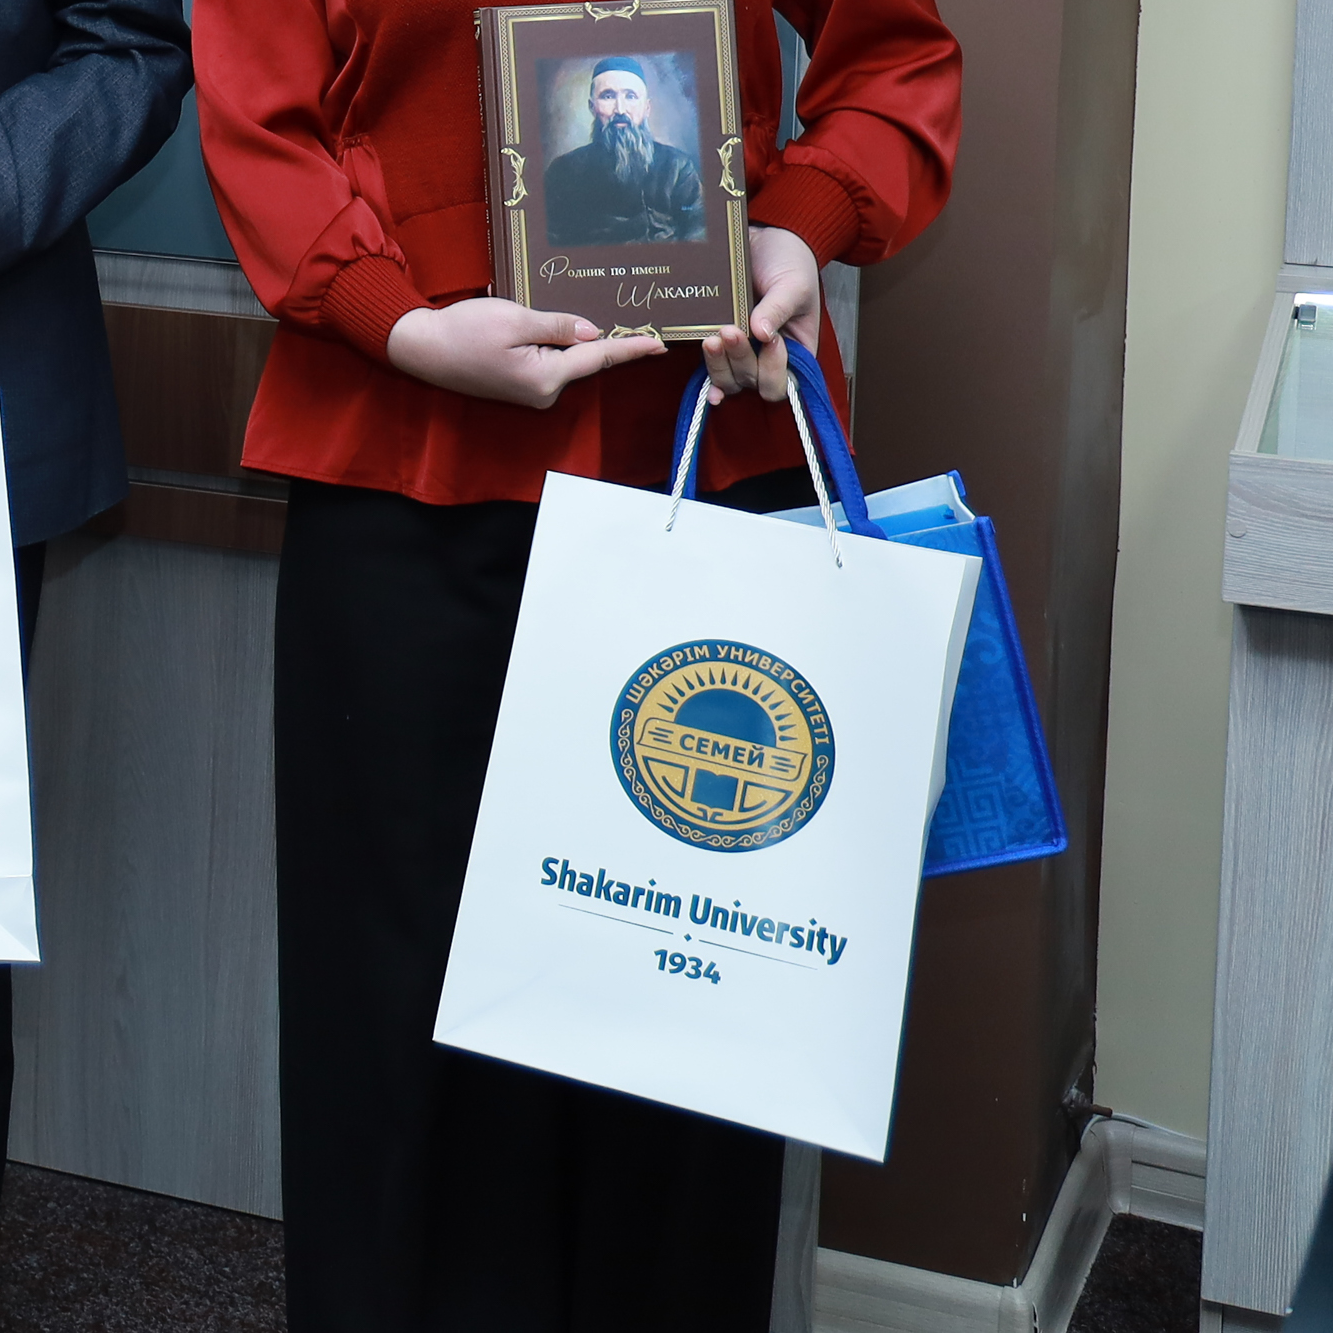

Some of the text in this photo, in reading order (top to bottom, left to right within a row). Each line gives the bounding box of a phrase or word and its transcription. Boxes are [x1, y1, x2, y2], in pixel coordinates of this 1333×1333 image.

[539, 255, 671, 284] Родник по имени
[616, 282, 719, 310] ШАКАРИМ
[626, 644, 830, 745] ШӘКӘРІМ УНИВЕРСИТЕТІ
[679, 734, 764, 768] СЕМЕЙ
[541, 856, 848, 966] Shakarim University
[653, 949, 721, 985] 1934
